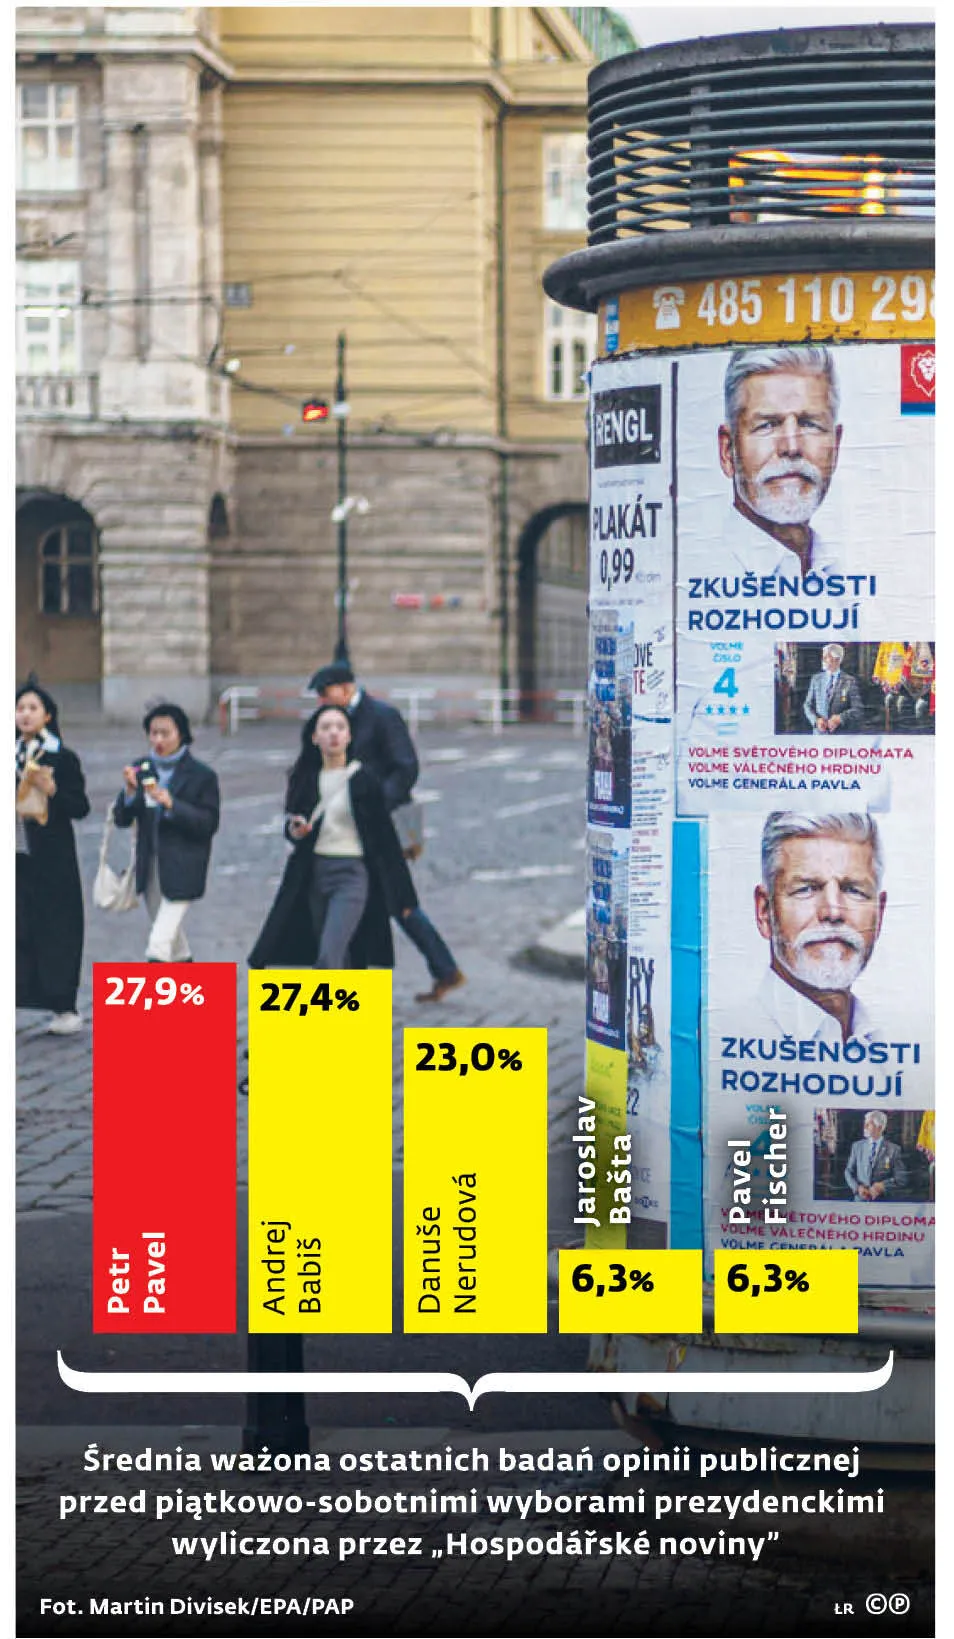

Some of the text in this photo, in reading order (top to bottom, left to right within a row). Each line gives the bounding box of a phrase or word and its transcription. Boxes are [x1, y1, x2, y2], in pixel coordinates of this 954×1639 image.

[696, 272, 935, 327] 485 110 29
[595, 407, 653, 447] RENGL
[593, 493, 663, 541] PLAKÁT
[600, 548, 634, 592] 0,99
[687, 571, 877, 599] ZKUŠENOSTI
[687, 602, 860, 631] ROZHODUJÍ
[713, 666, 739, 698] 4
[688, 745, 914, 759] VOLME SVĚTOVÉHO DIPLOMATA
[688, 761, 882, 775] VOLME VÁLEČNÉHO HRDINU
[688, 776, 861, 790] VOLME GENERÁLA PAVLA
[721, 1034, 921, 1065] ZKUŠENOSTI
[721, 1069, 904, 1098] ROZHODUJÍ
[721, 1223, 926, 1243] VOLME VÁLEČNÉHO HRDINU
[721, 1238, 765, 1250] VOLME
